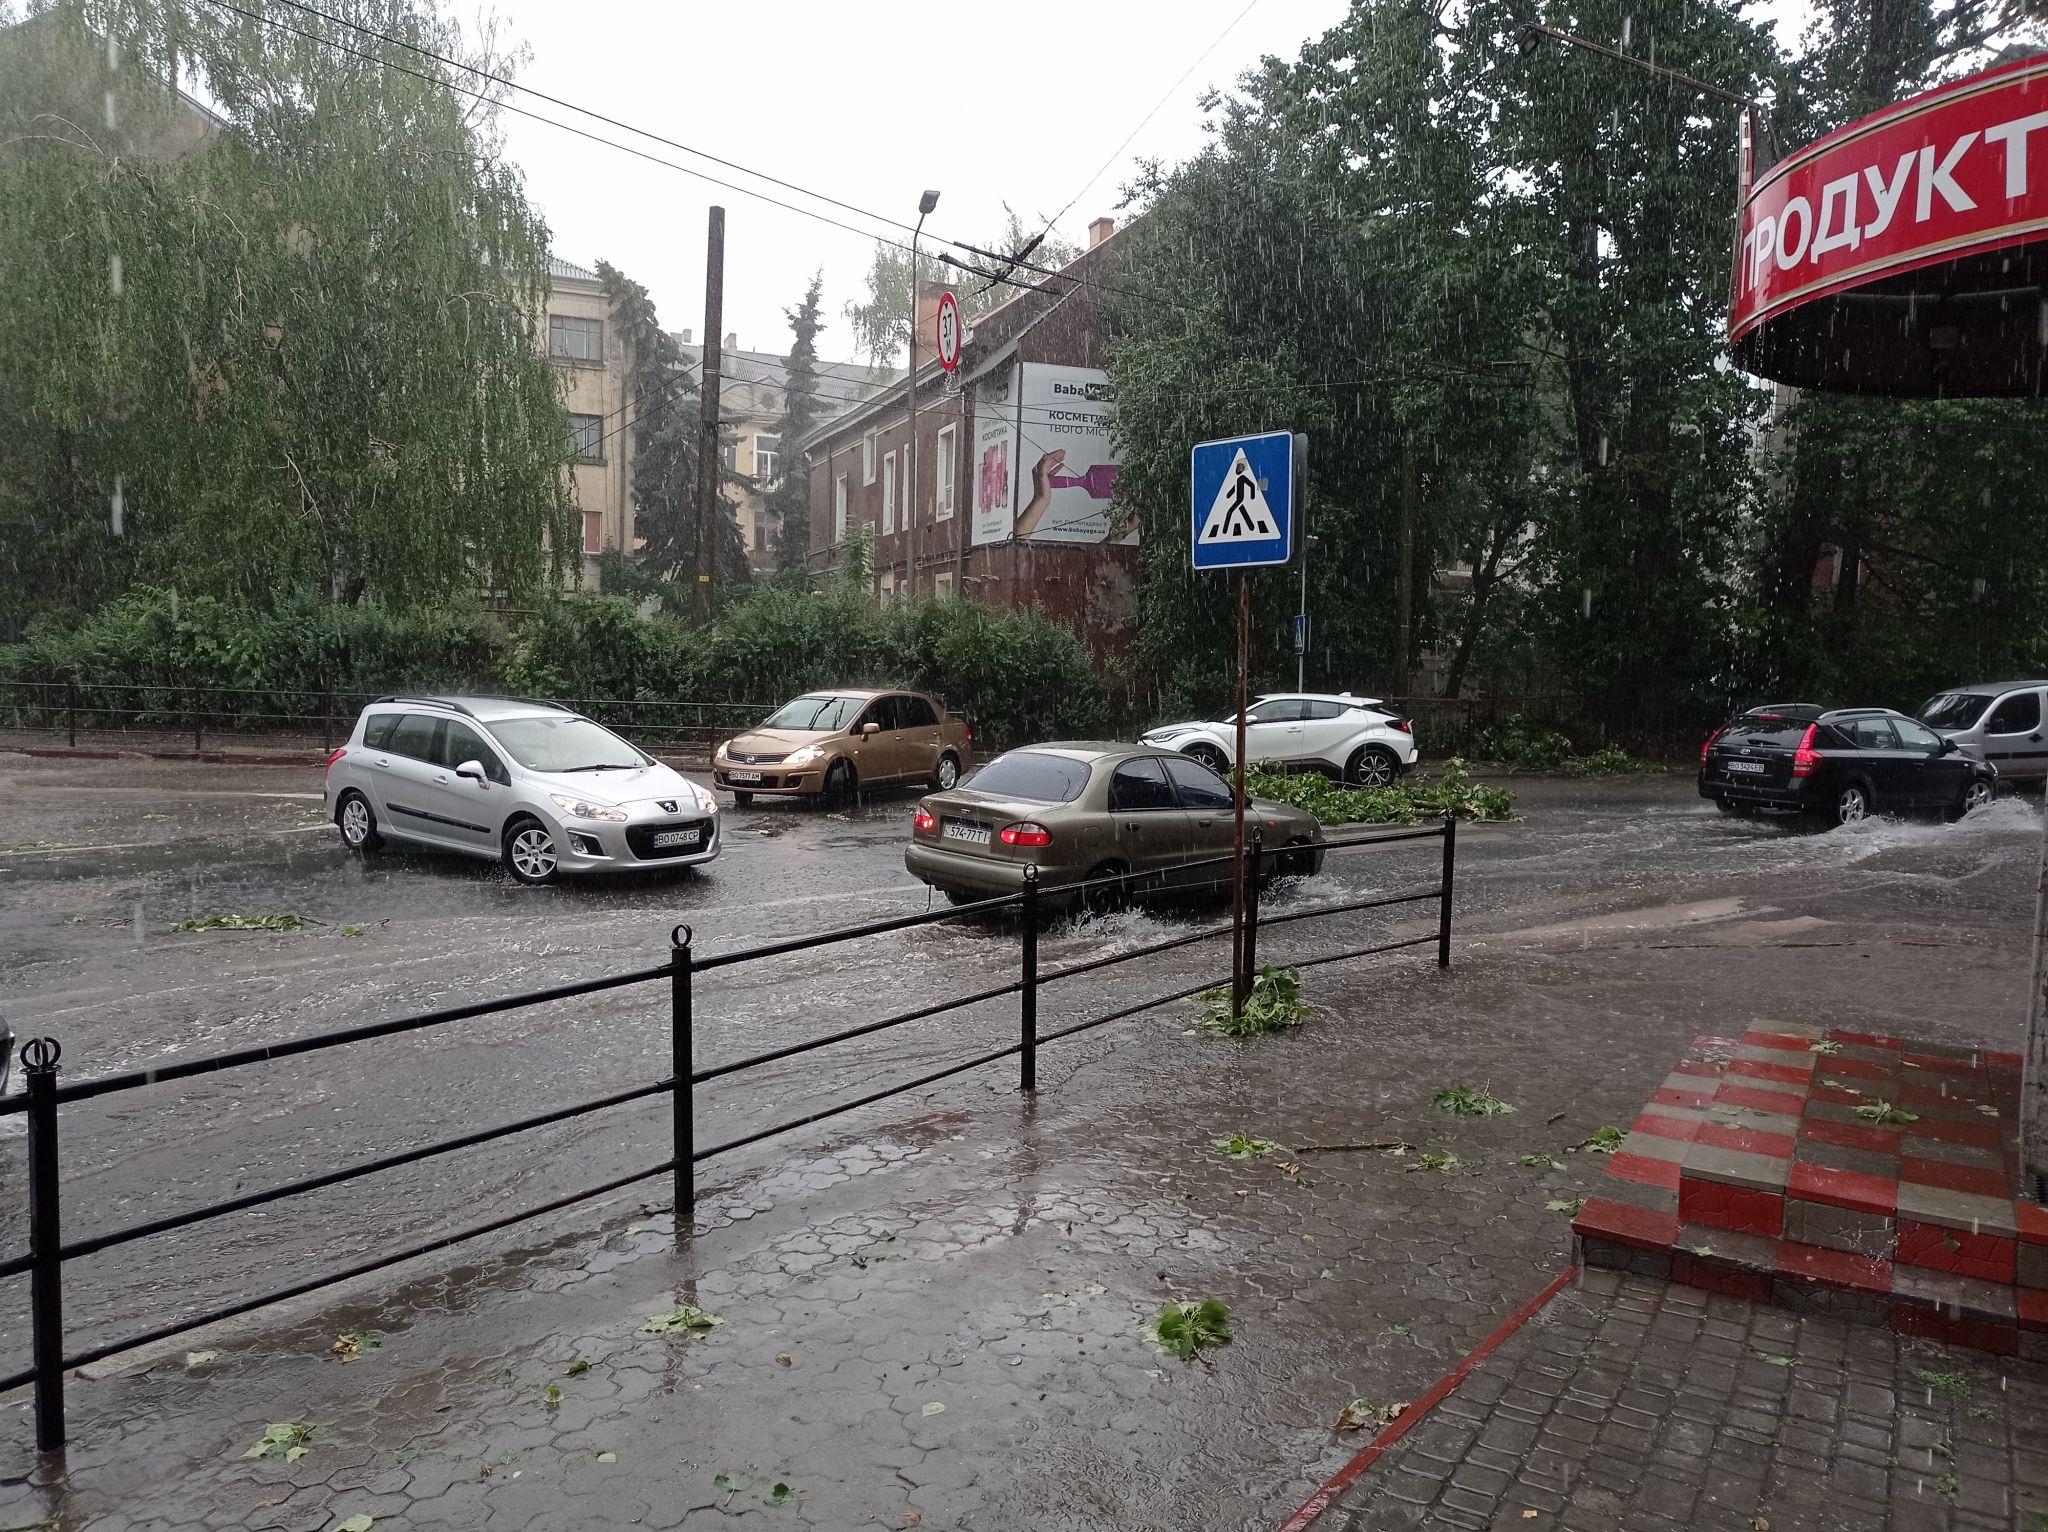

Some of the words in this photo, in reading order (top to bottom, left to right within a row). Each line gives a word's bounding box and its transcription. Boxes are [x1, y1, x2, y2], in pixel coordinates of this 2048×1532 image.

[1740, 110, 2048, 300] ПРОДУКТ
[658, 834, 670, 844] BO
[670, 832, 688, 843] 0748
[688, 830, 699, 841] CP
